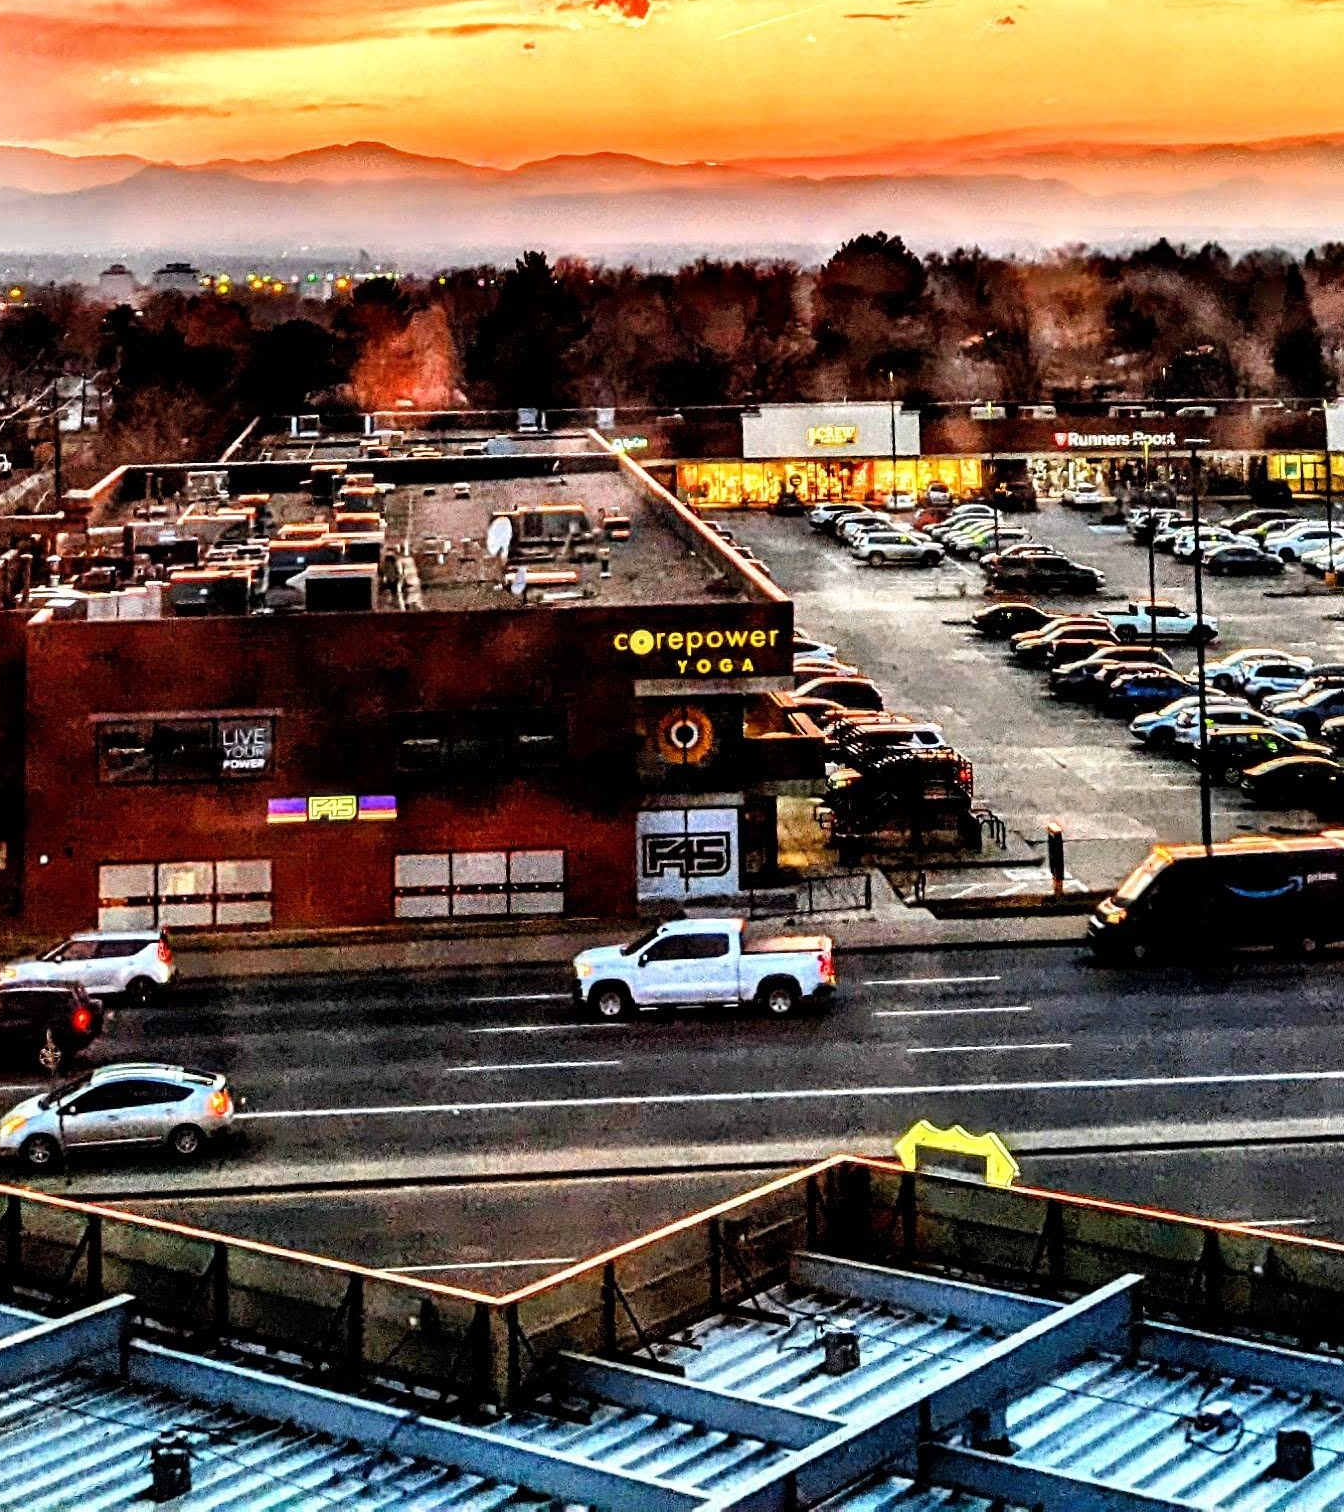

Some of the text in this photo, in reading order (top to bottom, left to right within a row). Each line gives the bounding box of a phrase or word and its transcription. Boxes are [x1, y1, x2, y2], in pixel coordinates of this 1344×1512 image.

[1068, 431, 1129, 446] Runners
[613, 629, 779, 657] corepower
[677, 658, 754, 674] YOGA
[223, 728, 265, 746] LIVE
[223, 758, 266, 769] POWER
[309, 796, 356, 819] F45
[643, 832, 730, 877] F45
